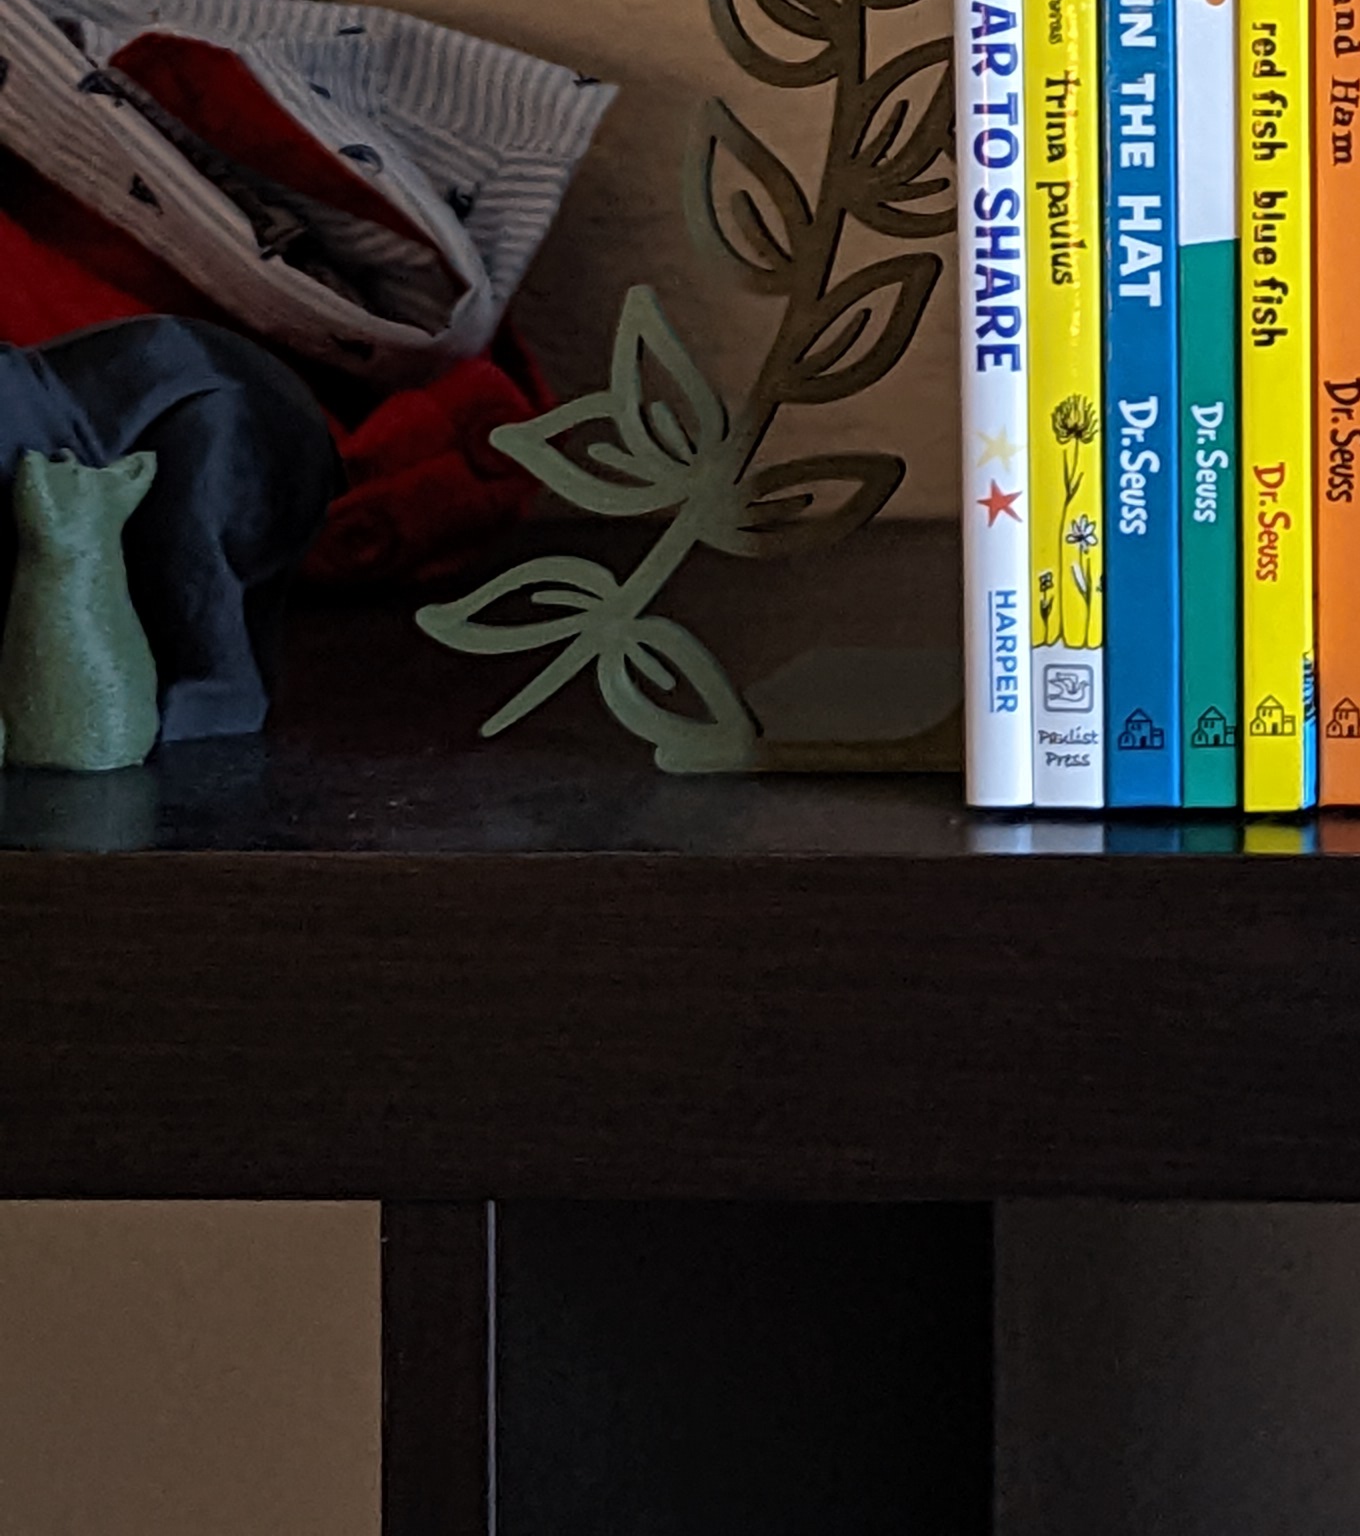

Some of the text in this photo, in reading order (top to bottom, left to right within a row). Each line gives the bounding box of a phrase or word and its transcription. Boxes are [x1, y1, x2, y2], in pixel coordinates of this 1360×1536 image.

[1251, 22, 1287, 79] red
[972, 92, 1020, 170] TO
[1119, 72, 1156, 168] THE
[1251, 89, 1288, 162] fish
[1330, 78, 1360, 166] Ham
[1118, 194, 1161, 307] HAT
[1252, 191, 1288, 266] blue
[973, 188, 1022, 372] SHARE
[1252, 275, 1288, 347] fish
[994, 589, 1018, 713] HARPER
